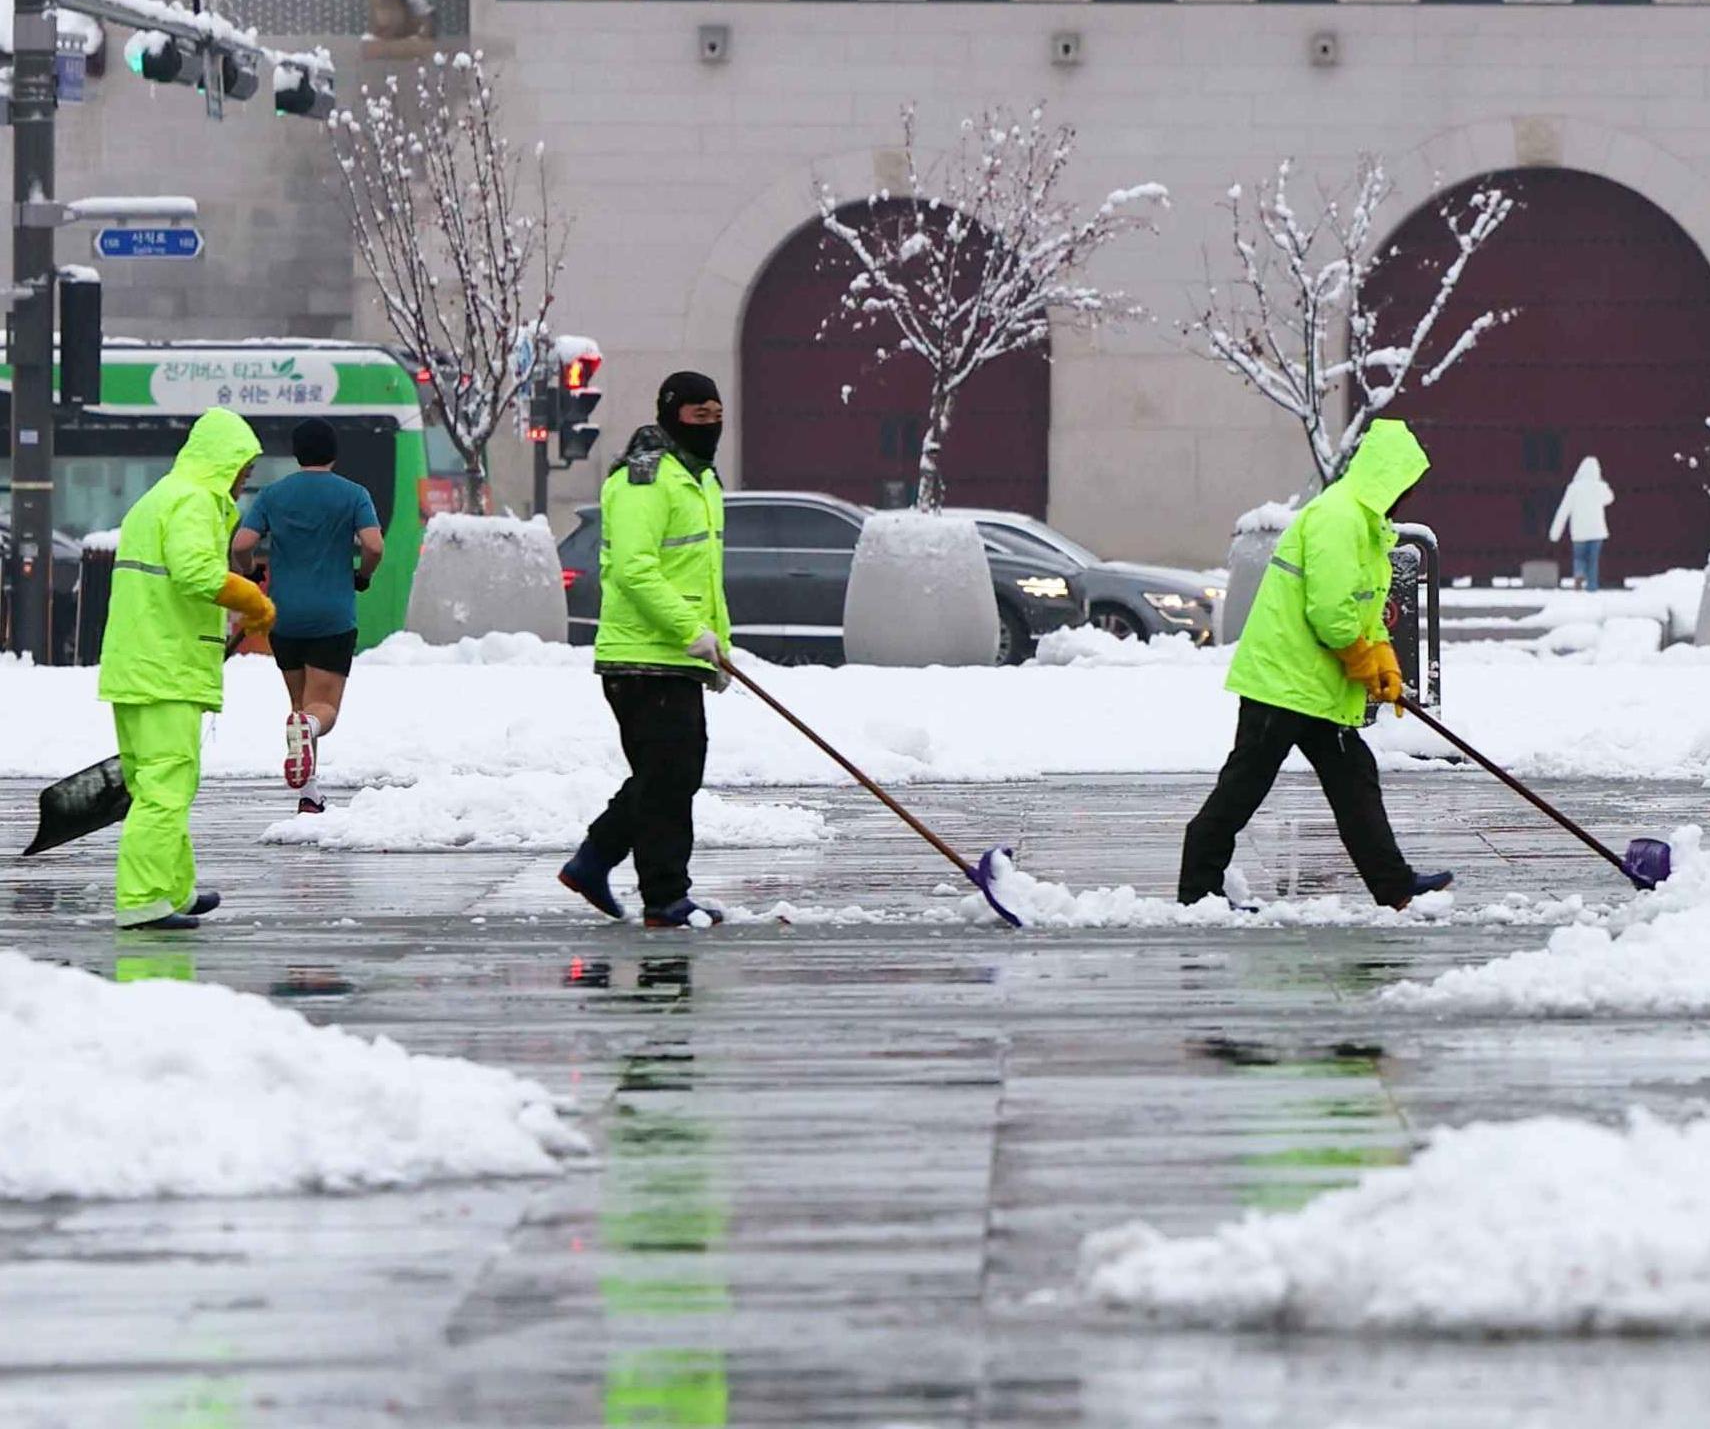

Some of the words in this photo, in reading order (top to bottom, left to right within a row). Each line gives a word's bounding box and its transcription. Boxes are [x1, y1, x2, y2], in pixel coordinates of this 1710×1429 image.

[132, 231, 167, 244] 사직로
[163, 361, 226, 381] 전기버스
[233, 362, 264, 380] 타고
[217, 385, 232, 404] 숨
[239, 385, 271, 404] 쉬는
[276, 385, 323, 404] 서울로
